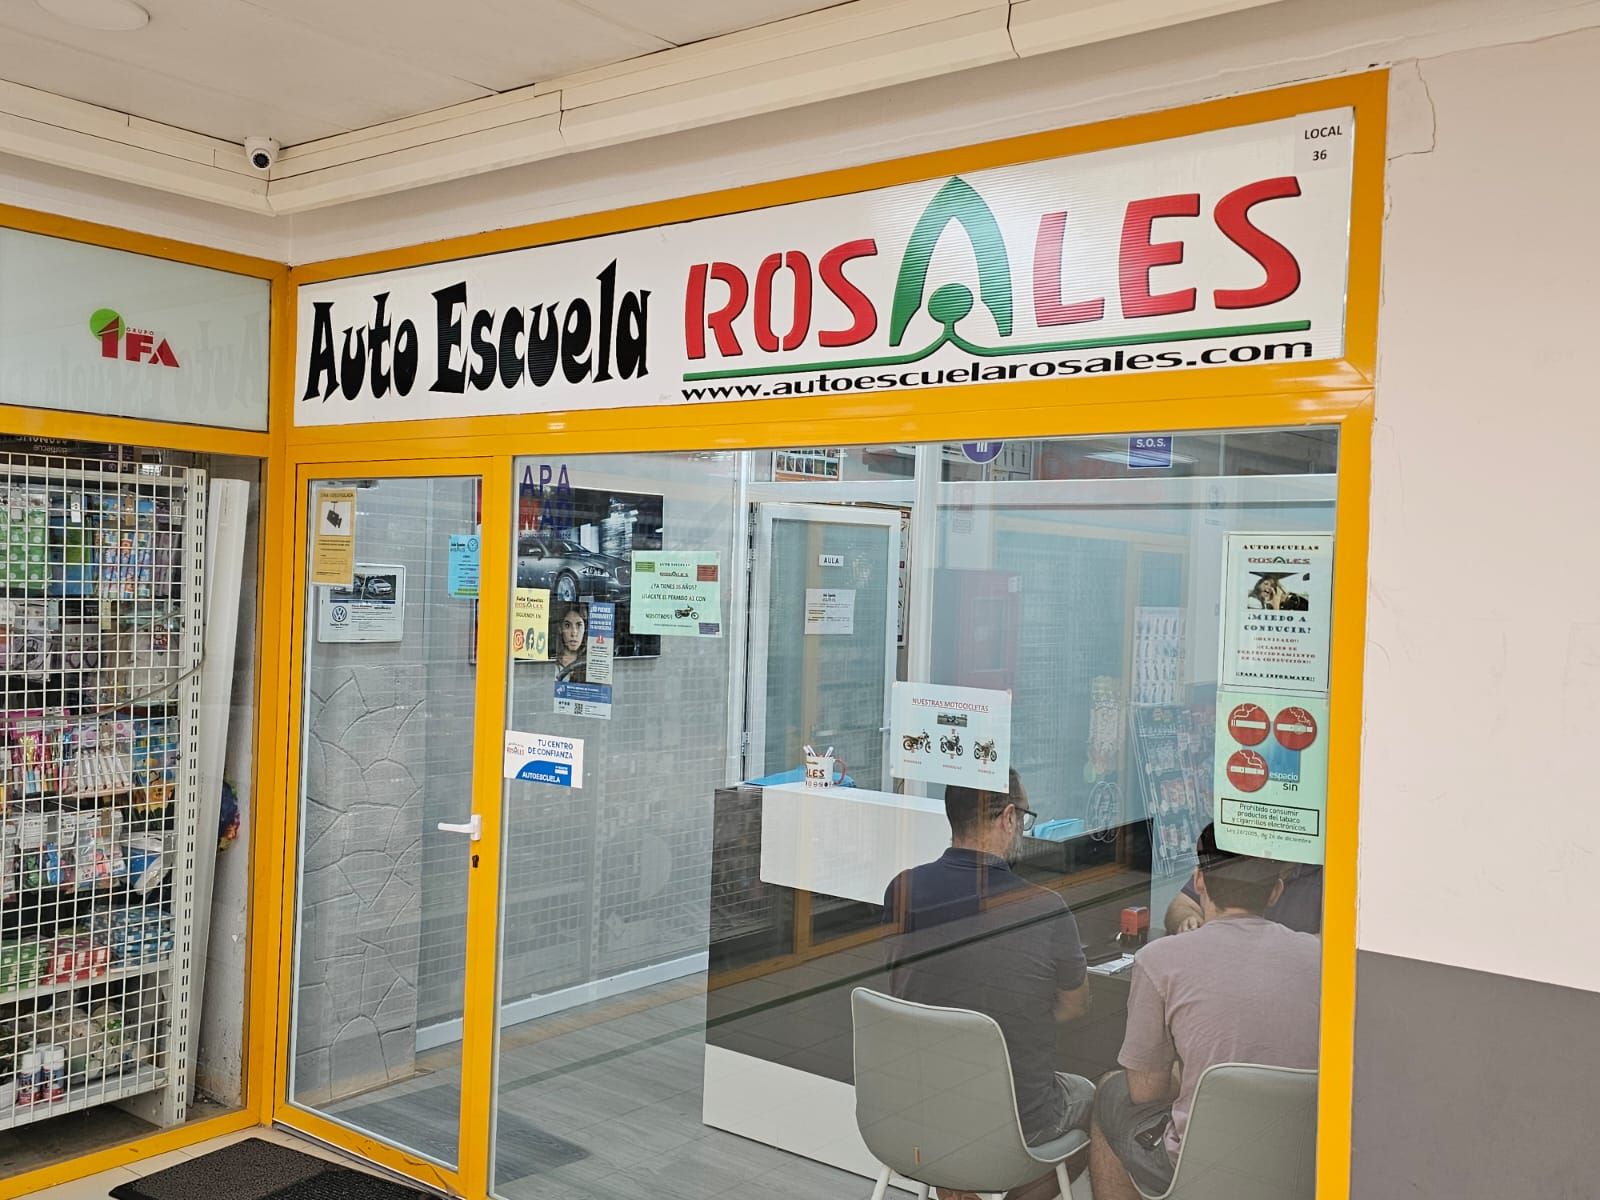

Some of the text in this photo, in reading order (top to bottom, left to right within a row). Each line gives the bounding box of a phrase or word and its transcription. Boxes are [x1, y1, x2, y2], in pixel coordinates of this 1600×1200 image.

[1304, 125, 1343, 140] LOCAL
[1312, 149, 1327, 161] 36
[685, 175, 1302, 360] ROSALES
[126, 327, 154, 336] GRUPO
[301, 258, 652, 403] Auto Escuela
[681, 341, 1313, 402] www.autoescuelarosales.com
[1136, 438, 1166, 448] S.O.S.
[823, 556, 840, 565] AULA
[1248, 556, 1311, 565] ROSALES
[912, 697, 989, 712] NUESTRAS MOTOCICLETAS
[538, 739, 574, 750] TU CENTRO
[528, 746, 573, 759] DE CONFIANZA
[522, 771, 561, 783] AUTOESCUELA
[1269, 771, 1299, 782] espacio
[1239, 803, 1299, 817] Prohibido consumir
[1237, 810, 1268, 820] productos
[1279, 815, 1300, 824] tabaco
[1236, 816, 1267, 827] cigarrillos
[1267, 820, 1306, 832] electrónicos
